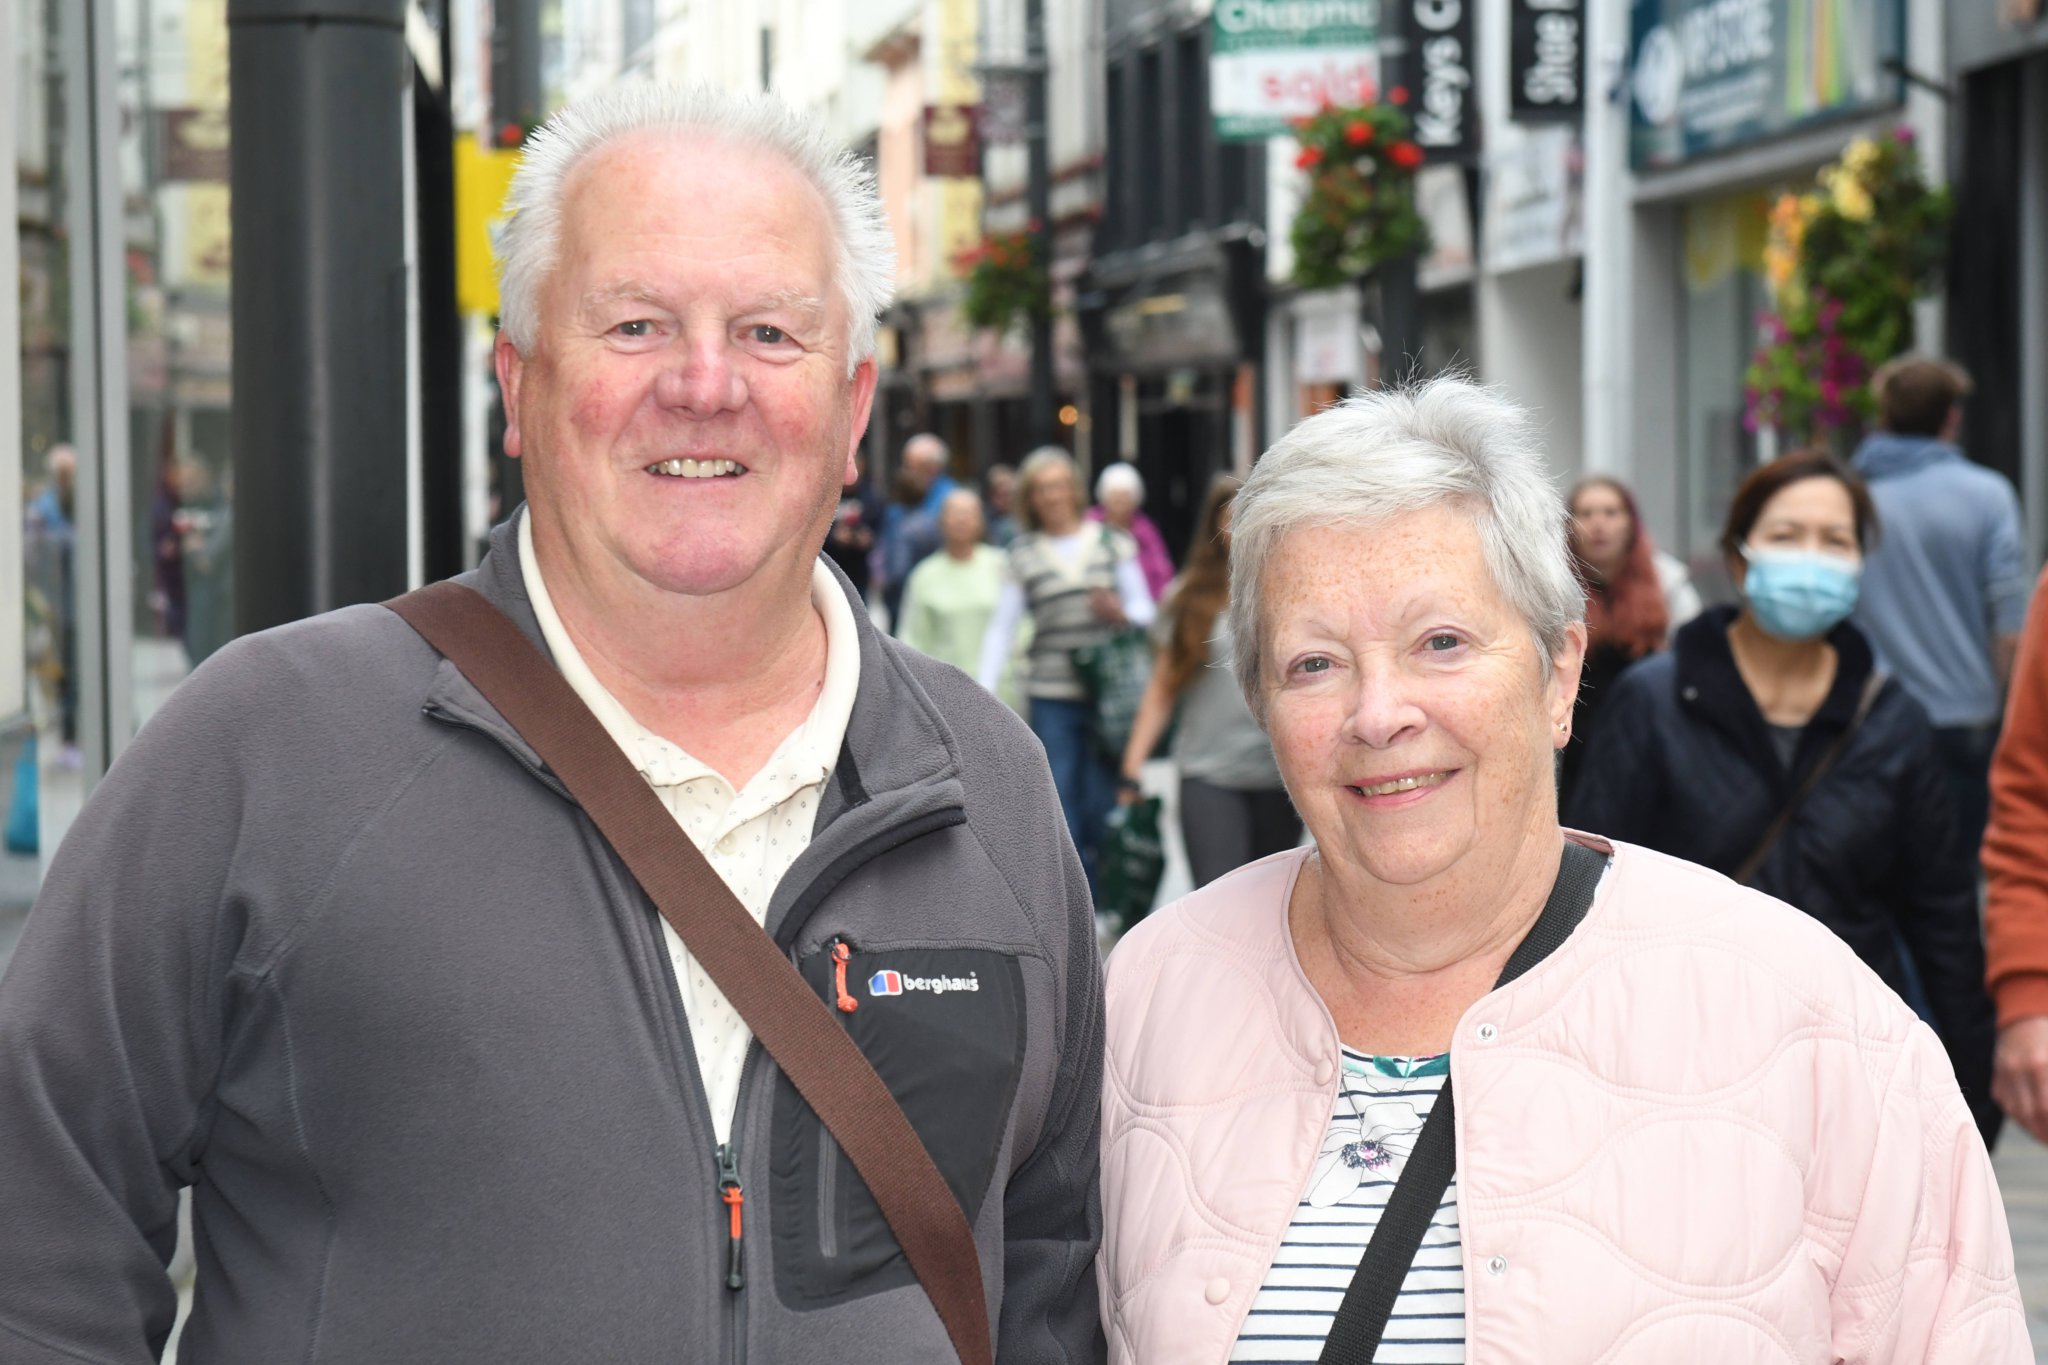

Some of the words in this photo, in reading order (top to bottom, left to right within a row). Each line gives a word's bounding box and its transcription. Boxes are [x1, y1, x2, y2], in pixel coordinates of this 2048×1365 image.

[1261, 58, 1377, 104] sold
[1417, 37, 1468, 144] Keys
[1526, 14, 1576, 103] Shoe
[903, 973, 979, 994] berghaus
